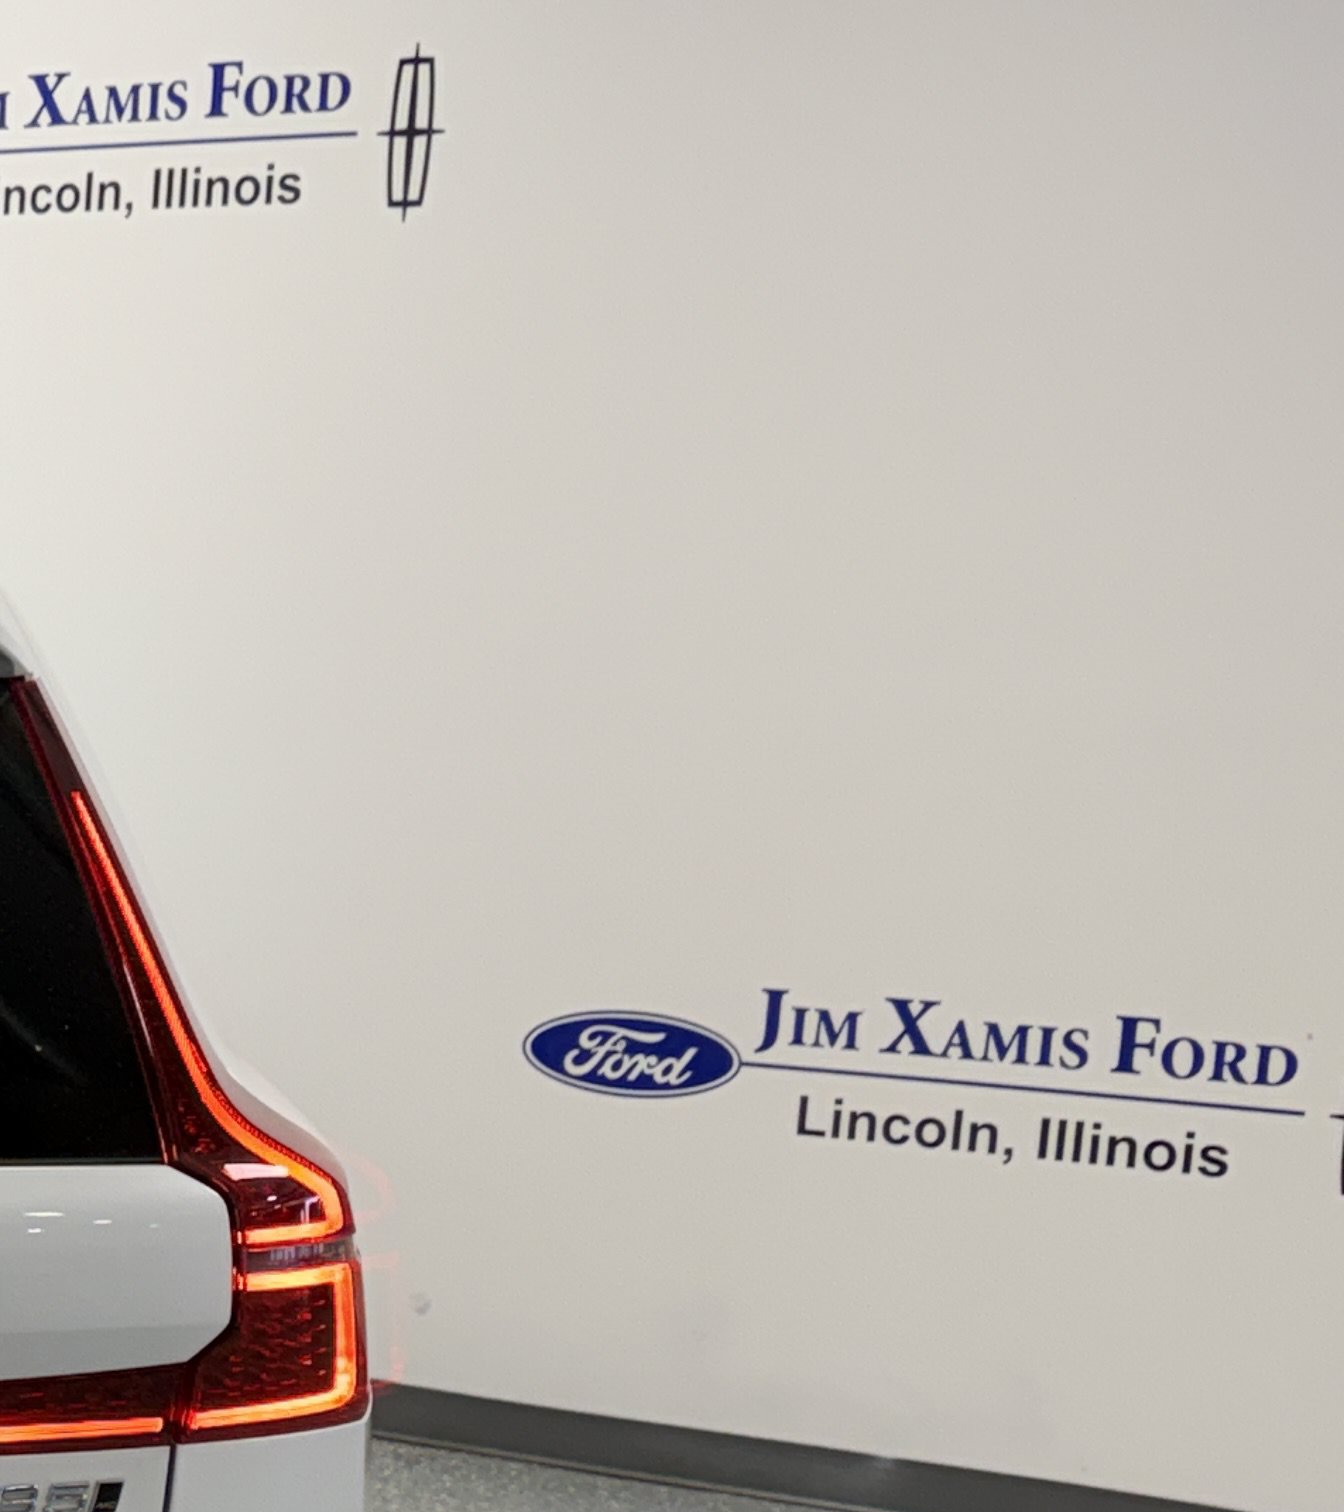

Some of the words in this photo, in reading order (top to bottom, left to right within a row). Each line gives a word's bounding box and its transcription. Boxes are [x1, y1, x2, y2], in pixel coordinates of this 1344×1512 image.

[24, 71, 188, 130] XAMIS
[203, 60, 352, 118] FORD
[150, 163, 302, 209] Illinois
[562, 1023, 695, 1086] Ford
[754, 988, 862, 1054] JIM
[879, 997, 1090, 1070] XAMIS
[1110, 1014, 1300, 1088] FORD
[795, 1095, 1016, 1164] Lincoln,
[1036, 1118, 1230, 1178] Illinois
